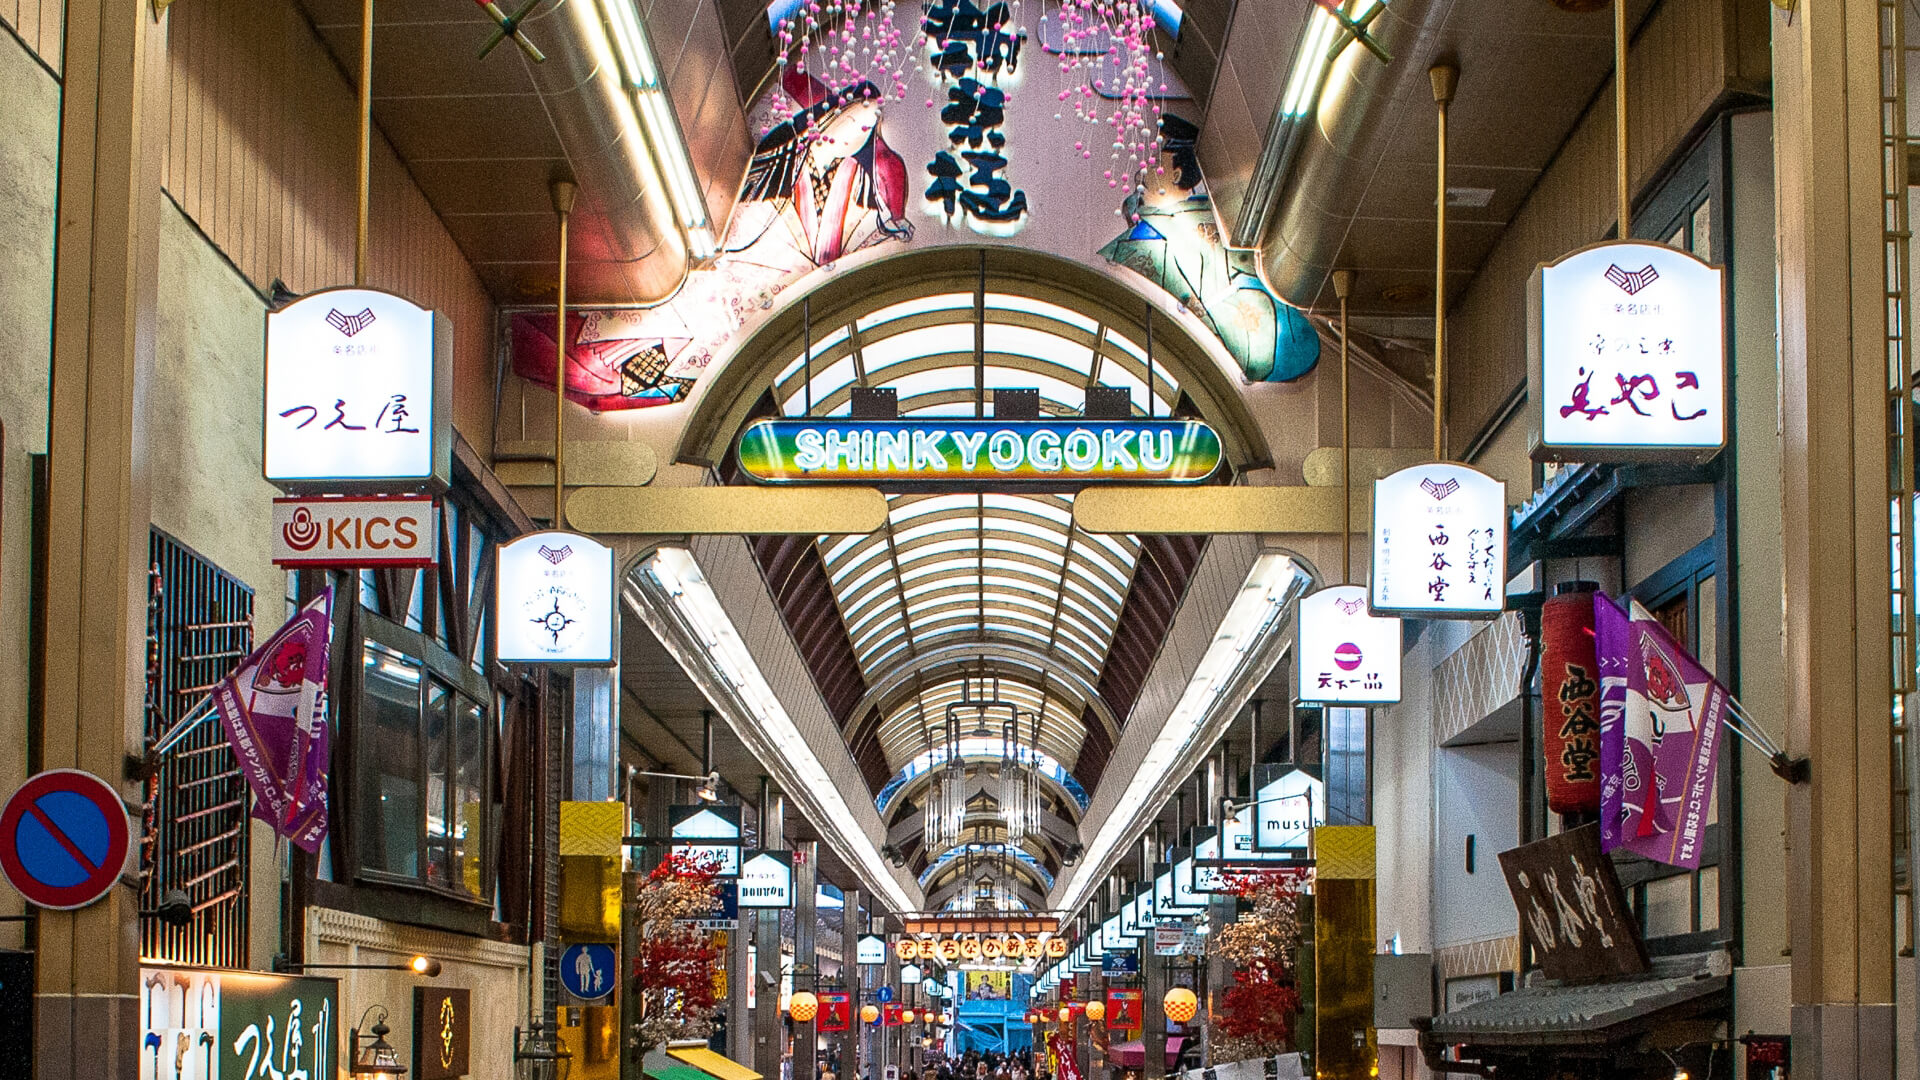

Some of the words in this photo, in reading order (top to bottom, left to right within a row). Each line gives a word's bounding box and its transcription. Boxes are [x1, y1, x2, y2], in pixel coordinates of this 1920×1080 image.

[921, 0, 1028, 223] 新京極
[279, 393, 420, 434] つえ屋
[795, 429, 1174, 472] SHINKYOGOKU
[327, 516, 418, 550] KICS
[1428, 523, 1453, 602] 西谷堂
[1318, 672, 1384, 690] 天下一品
[1558, 662, 1600, 783] 西谷堂
[900, 940, 1064, 956] 京まちなか新京極
